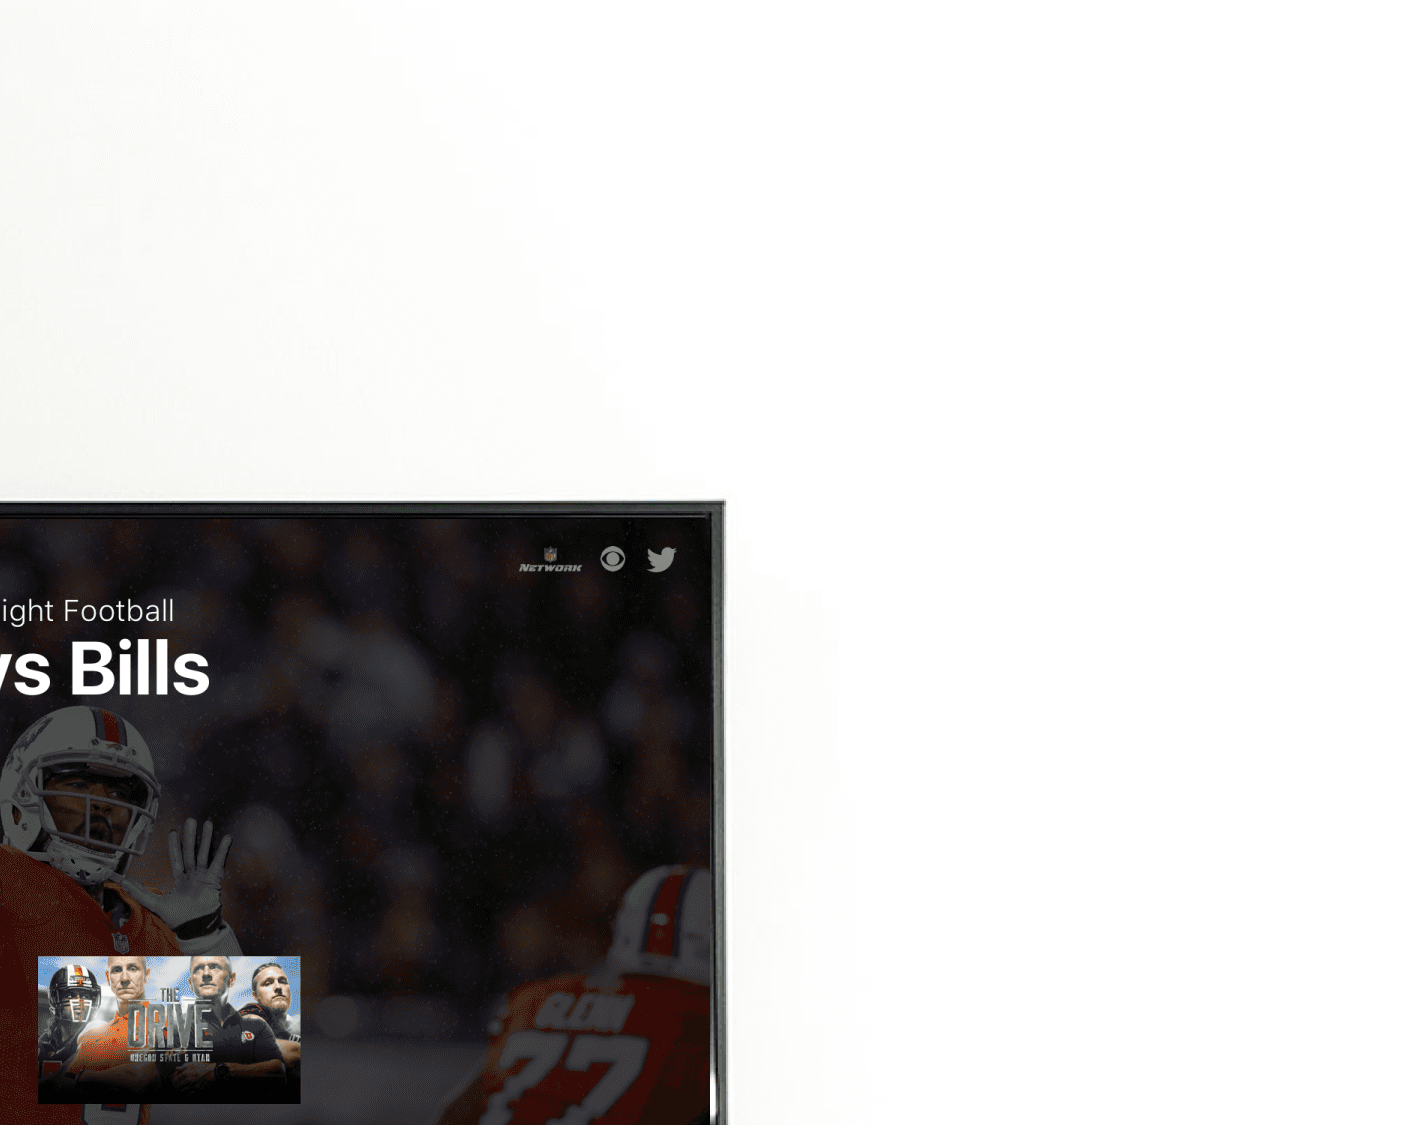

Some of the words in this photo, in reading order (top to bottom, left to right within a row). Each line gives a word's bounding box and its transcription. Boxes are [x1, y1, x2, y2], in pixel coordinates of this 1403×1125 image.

[518, 563, 583, 572] NETWORK
[64, 598, 173, 622] Football
[71, 638, 210, 696] Bills
[159, 987, 180, 1003] THE
[127, 1003, 214, 1049] DRIVE
[130, 1053, 157, 1062] OREGON
[159, 1053, 181, 1062] STATE
